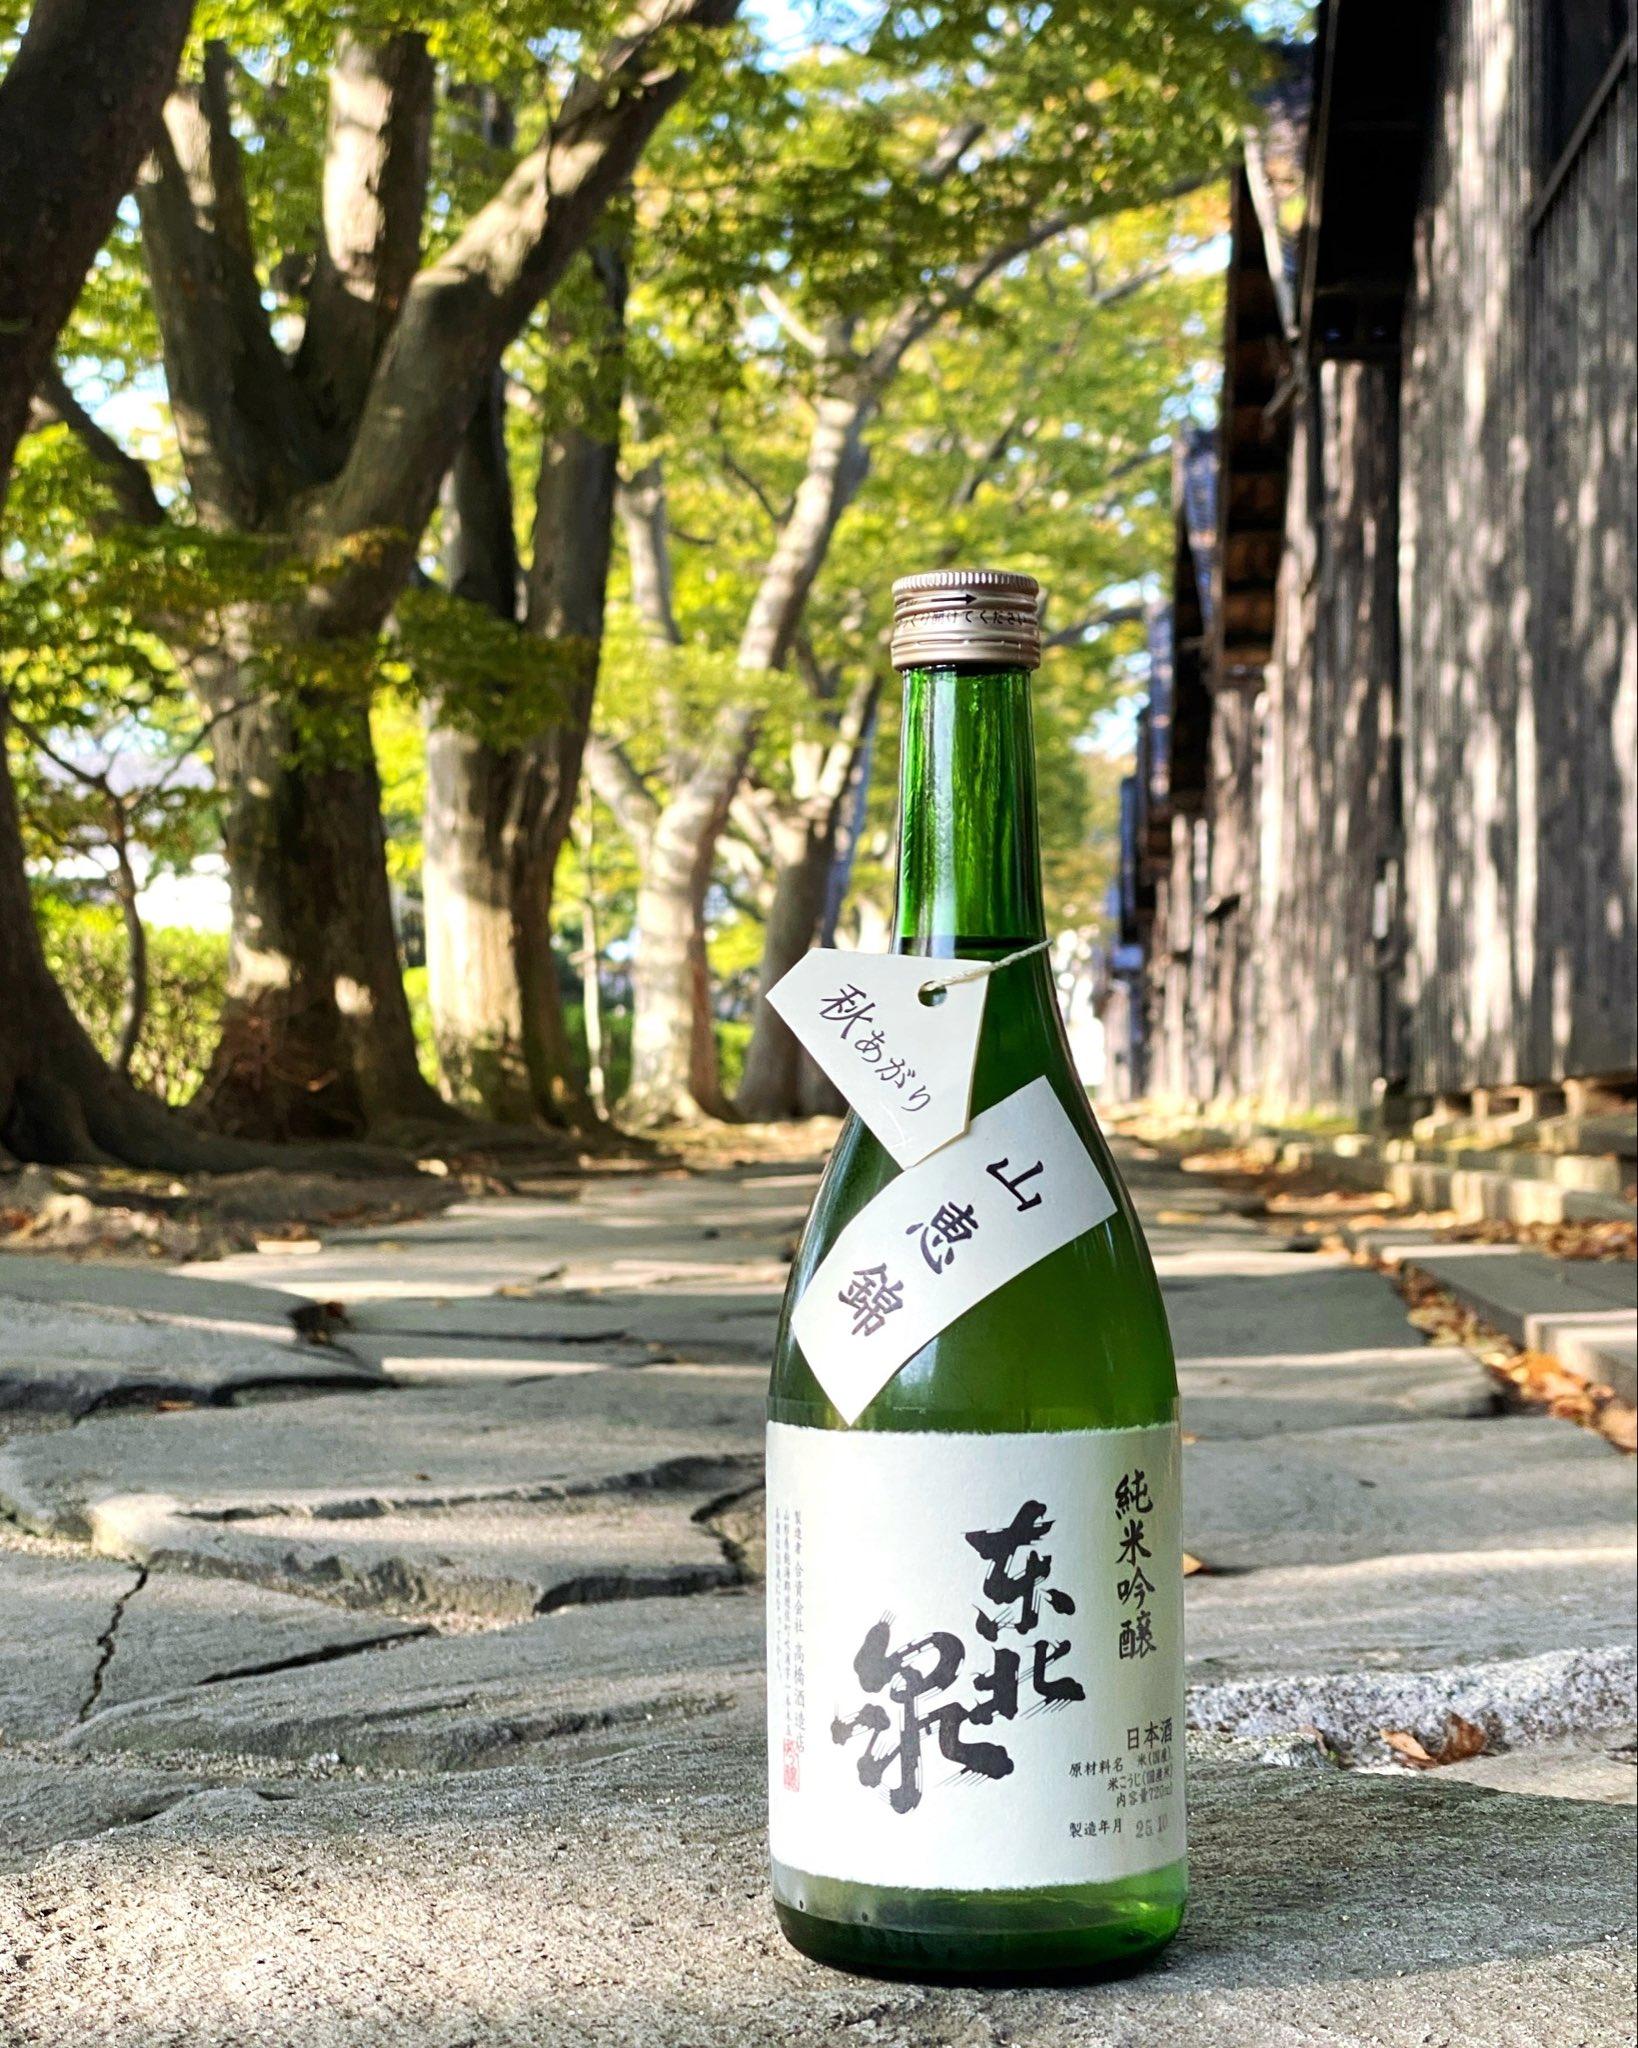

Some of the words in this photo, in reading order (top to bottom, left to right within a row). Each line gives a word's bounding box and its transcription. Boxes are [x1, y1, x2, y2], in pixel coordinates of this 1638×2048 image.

[818, 983, 931, 1112] 秋あがり
[838, 1156, 1044, 1337] 山恵錦
[1115, 1469, 1157, 1659] 純米吟醸
[1069, 1757, 1124, 1778] 原材料名
[1127, 1716, 1173, 1750] 日本酒
[1069, 1818, 1122, 1838] 製造年月
